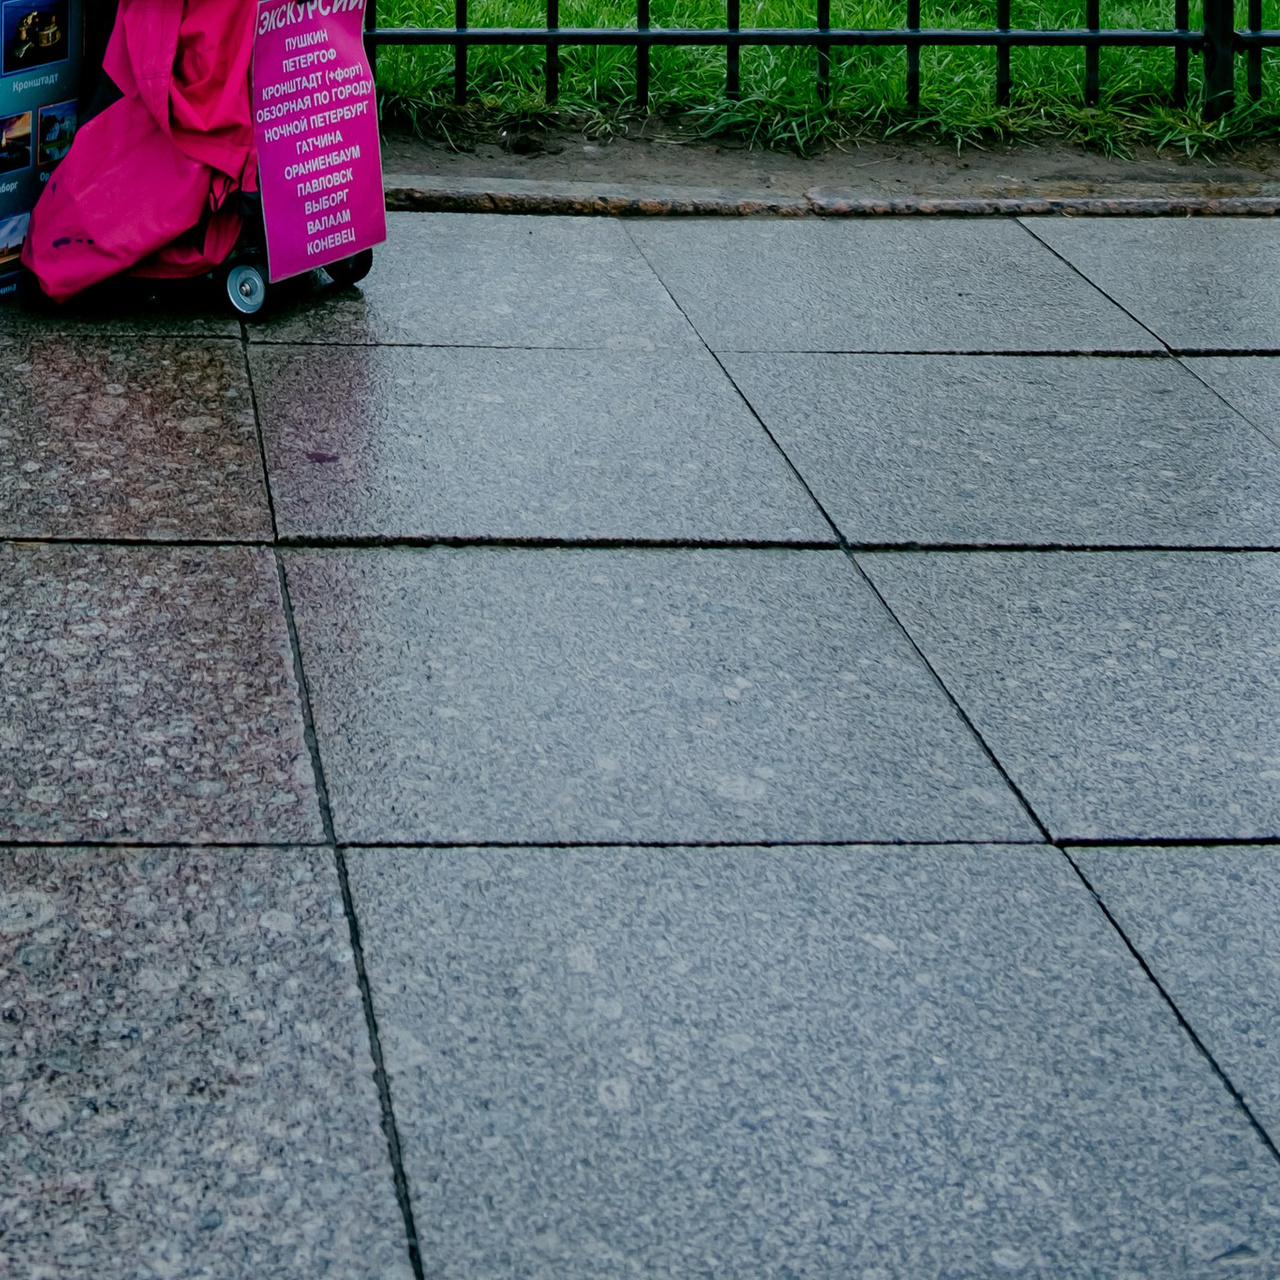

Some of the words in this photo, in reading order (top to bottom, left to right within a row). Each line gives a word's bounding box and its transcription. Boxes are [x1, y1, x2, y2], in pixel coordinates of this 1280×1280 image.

[285, 29, 328, 51] ПУШКИН
[282, 48, 337, 73] ПЕТЕРГОФ
[12, 73, 59, 92] Кронштадт
[262, 72, 323, 101] КРОНШТАДТ
[256, 95, 312, 123] ОБЗОРНАЯ
[314, 90, 330, 107] ПО
[332, 79, 372, 101] ГОРОДУ
[264, 113, 308, 143] НОЧНОЙ
[310, 101, 369, 129] ПЕТЕРБУРГ
[296, 130, 344, 155] ГАТЧИНА
[284, 145, 361, 180] ОРАНИЕНБАУМ
[297, 168, 354, 197] ПАВЛОВСК
[305, 189, 349, 215] ВЫБОРГ
[306, 209, 351, 235] ВАЛААМ
[307, 227, 356, 255] КОНЕВЕЦ
